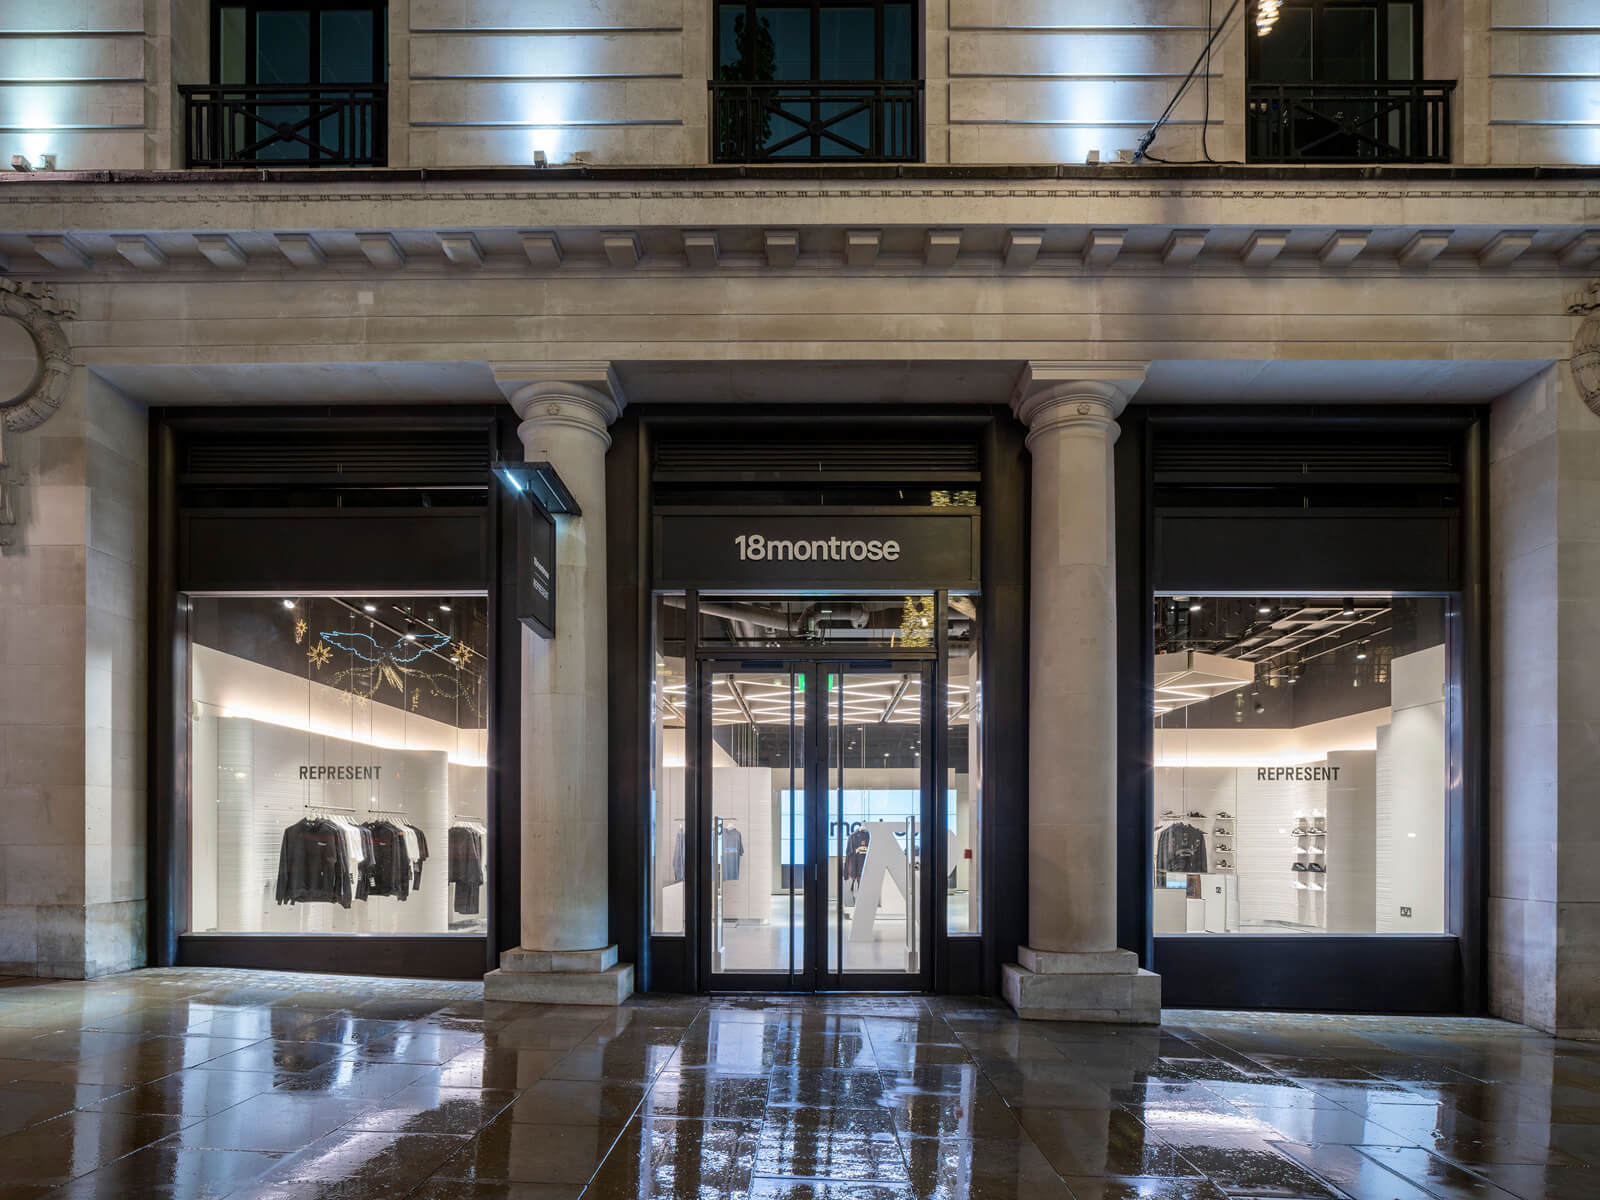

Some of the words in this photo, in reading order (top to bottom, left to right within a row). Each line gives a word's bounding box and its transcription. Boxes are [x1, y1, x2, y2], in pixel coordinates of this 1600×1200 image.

[735, 534, 900, 561] 18montrose
[299, 766, 381, 780] REPRESENT
[1257, 767, 1340, 781] REPRESENT
